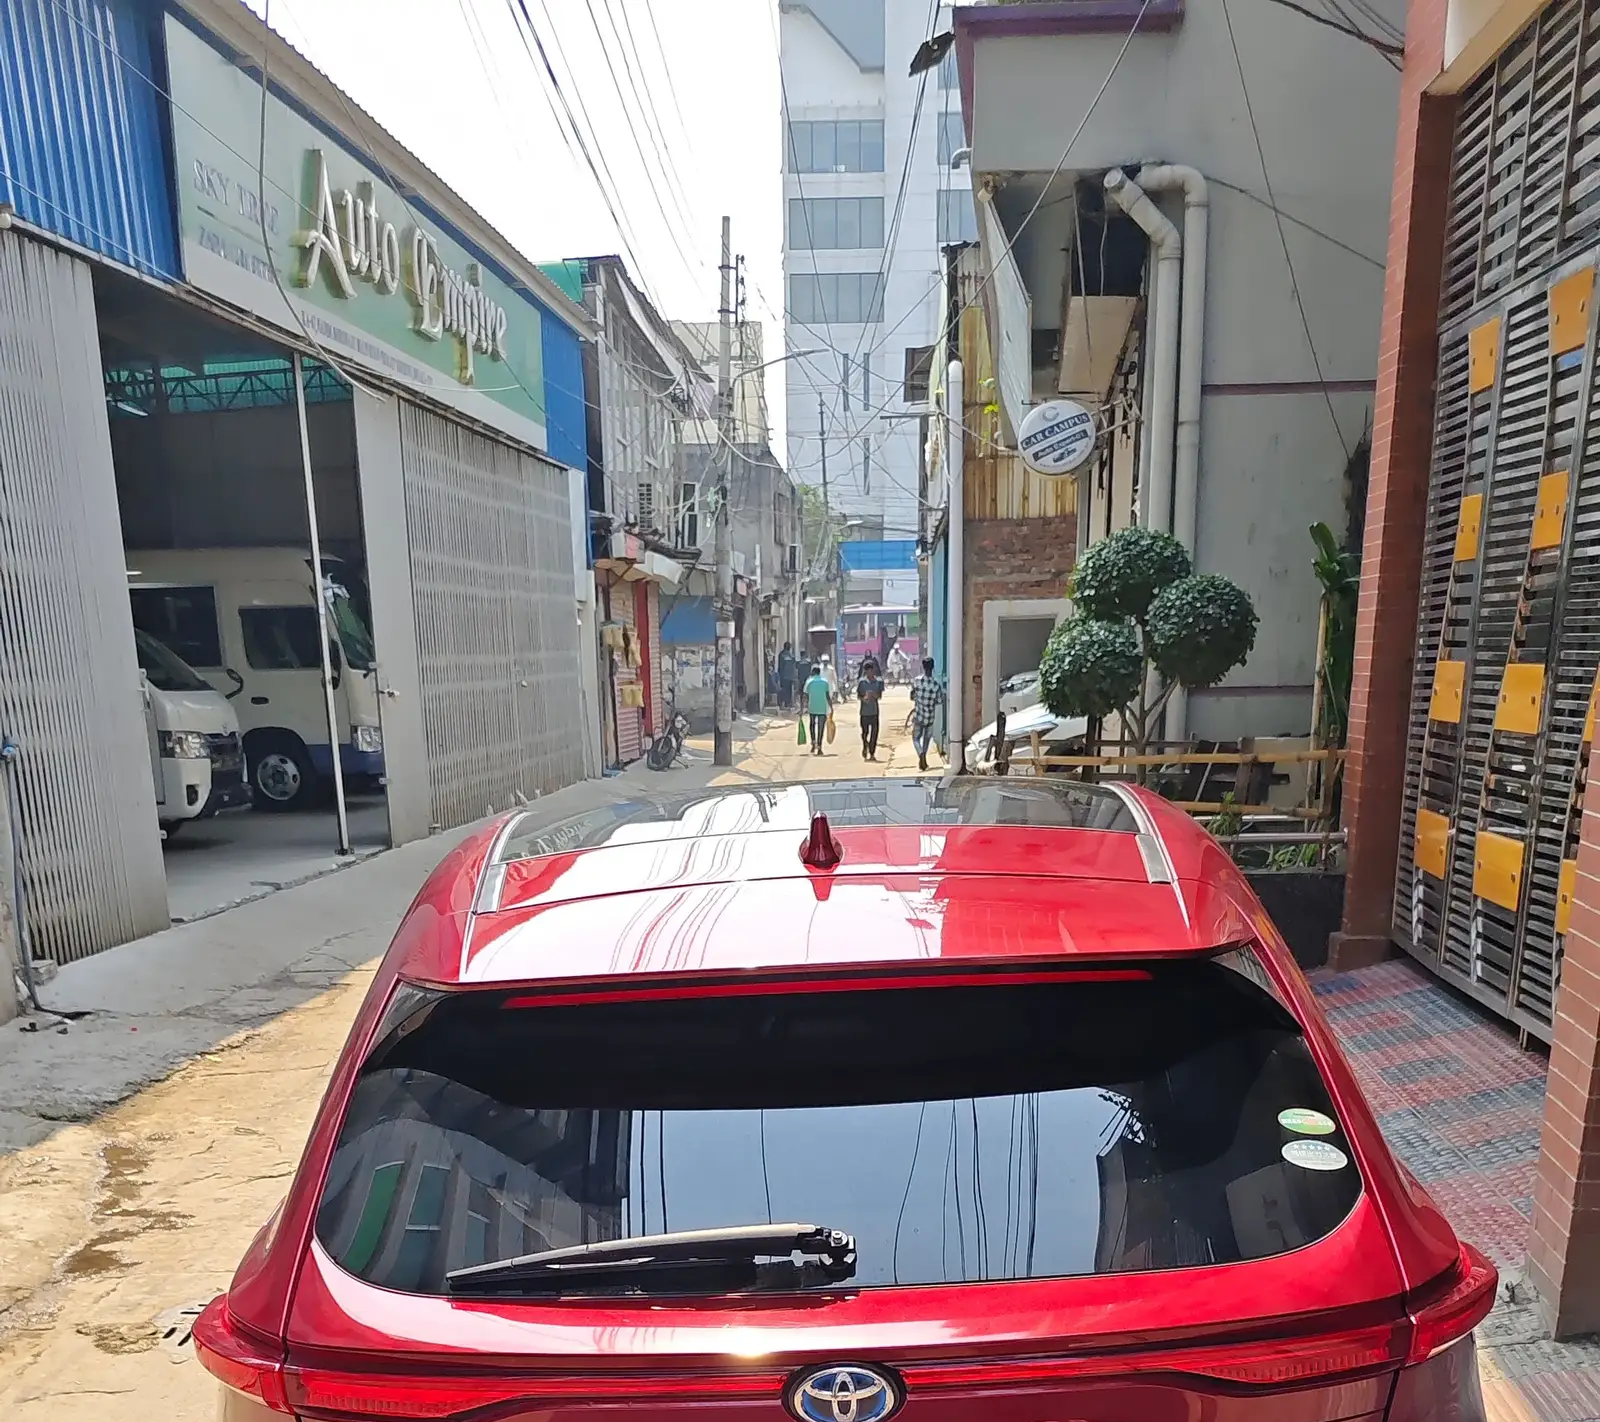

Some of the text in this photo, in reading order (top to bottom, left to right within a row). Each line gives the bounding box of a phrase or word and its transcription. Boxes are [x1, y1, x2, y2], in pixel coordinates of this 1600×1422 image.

[193, 159, 230, 206] SKY
[301, 147, 399, 299] Auto
[1022, 433, 1045, 448] CAR
[1045, 414, 1088, 437] CAMPUS
